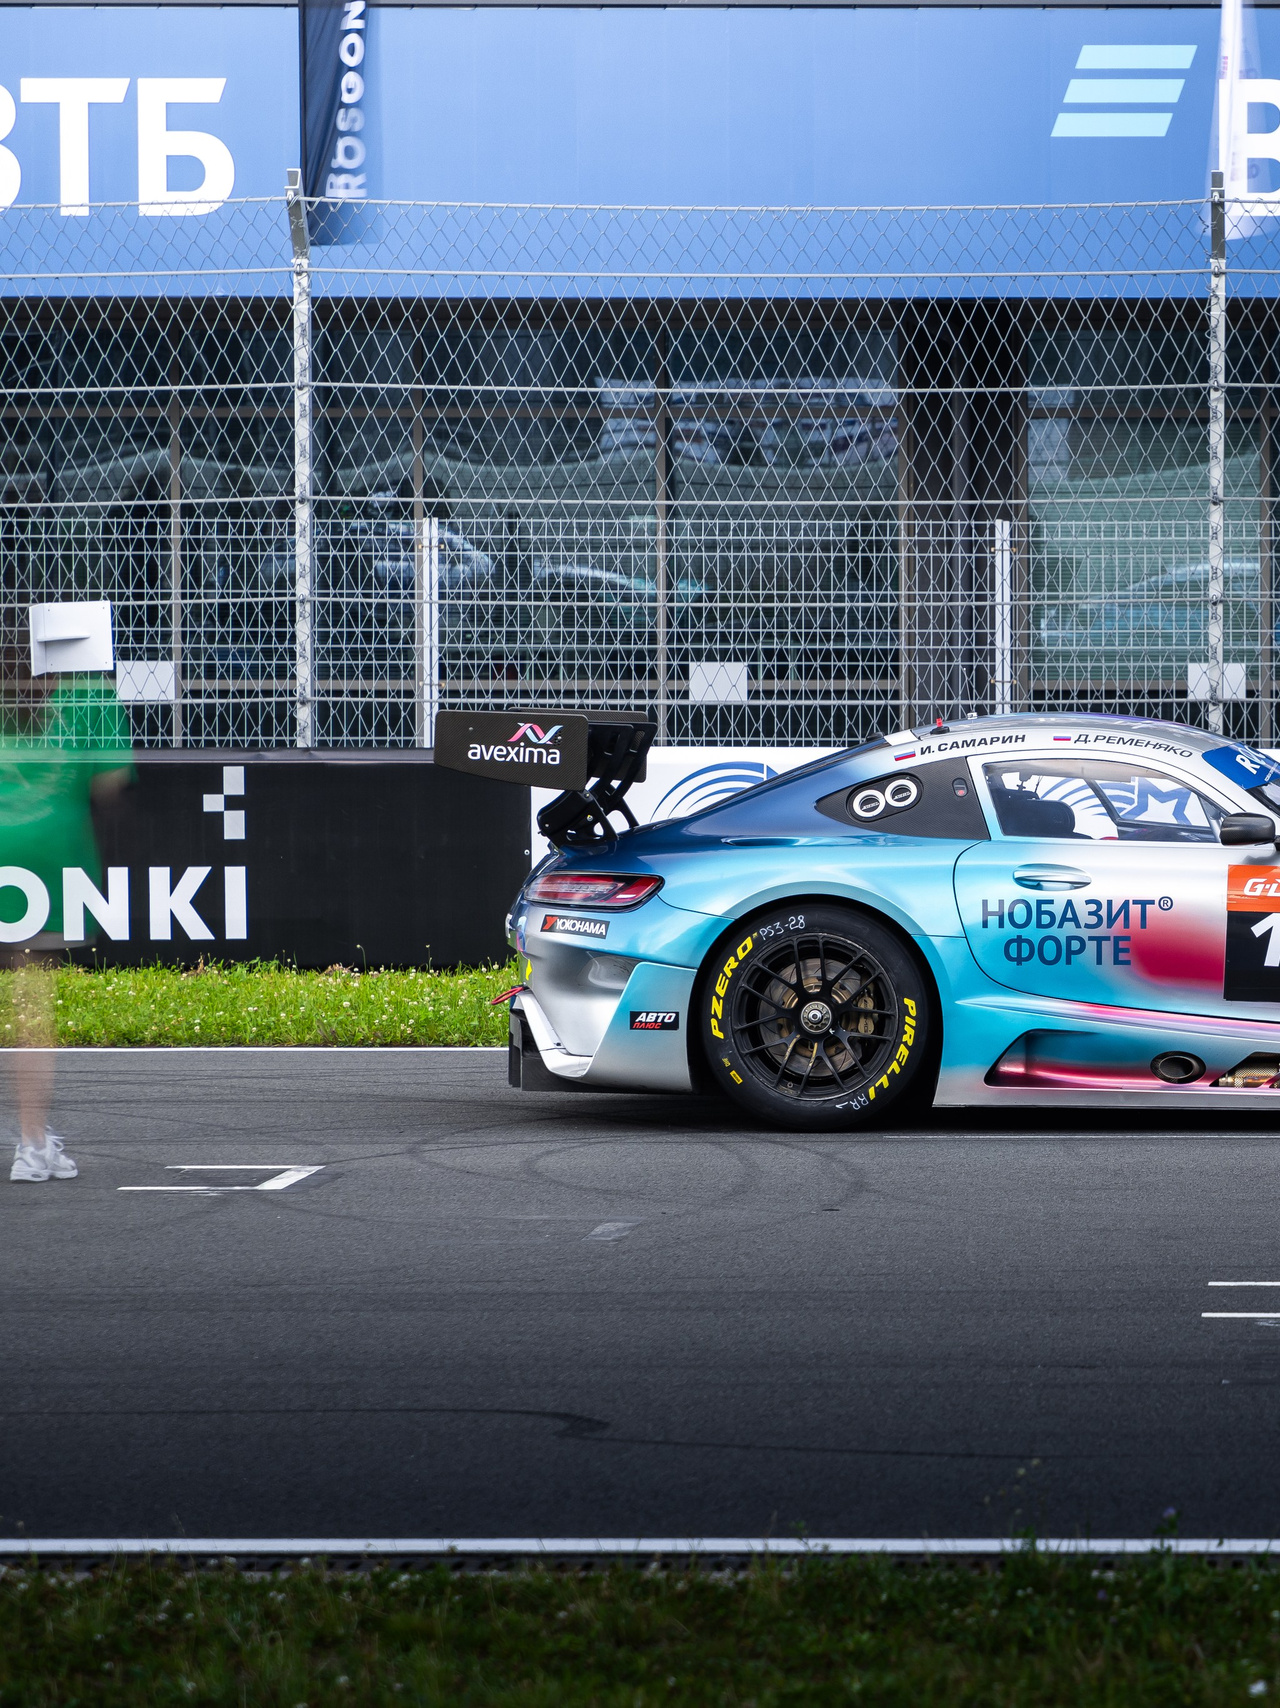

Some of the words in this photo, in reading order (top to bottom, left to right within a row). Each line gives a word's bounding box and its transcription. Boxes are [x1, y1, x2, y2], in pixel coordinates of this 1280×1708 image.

[0, 78, 236, 217] ТБ
[467, 741, 561, 765] avexima
[0, 866, 247, 943] ONKI
[556, 918, 606, 936] YOKOHAMA
[759, 914, 807, 941] PS3-28
[1003, 934, 1132, 967] ФОРТЕ
[635, 1012, 676, 1023] АВТО
[868, 997, 916, 1100] PIRELLI
